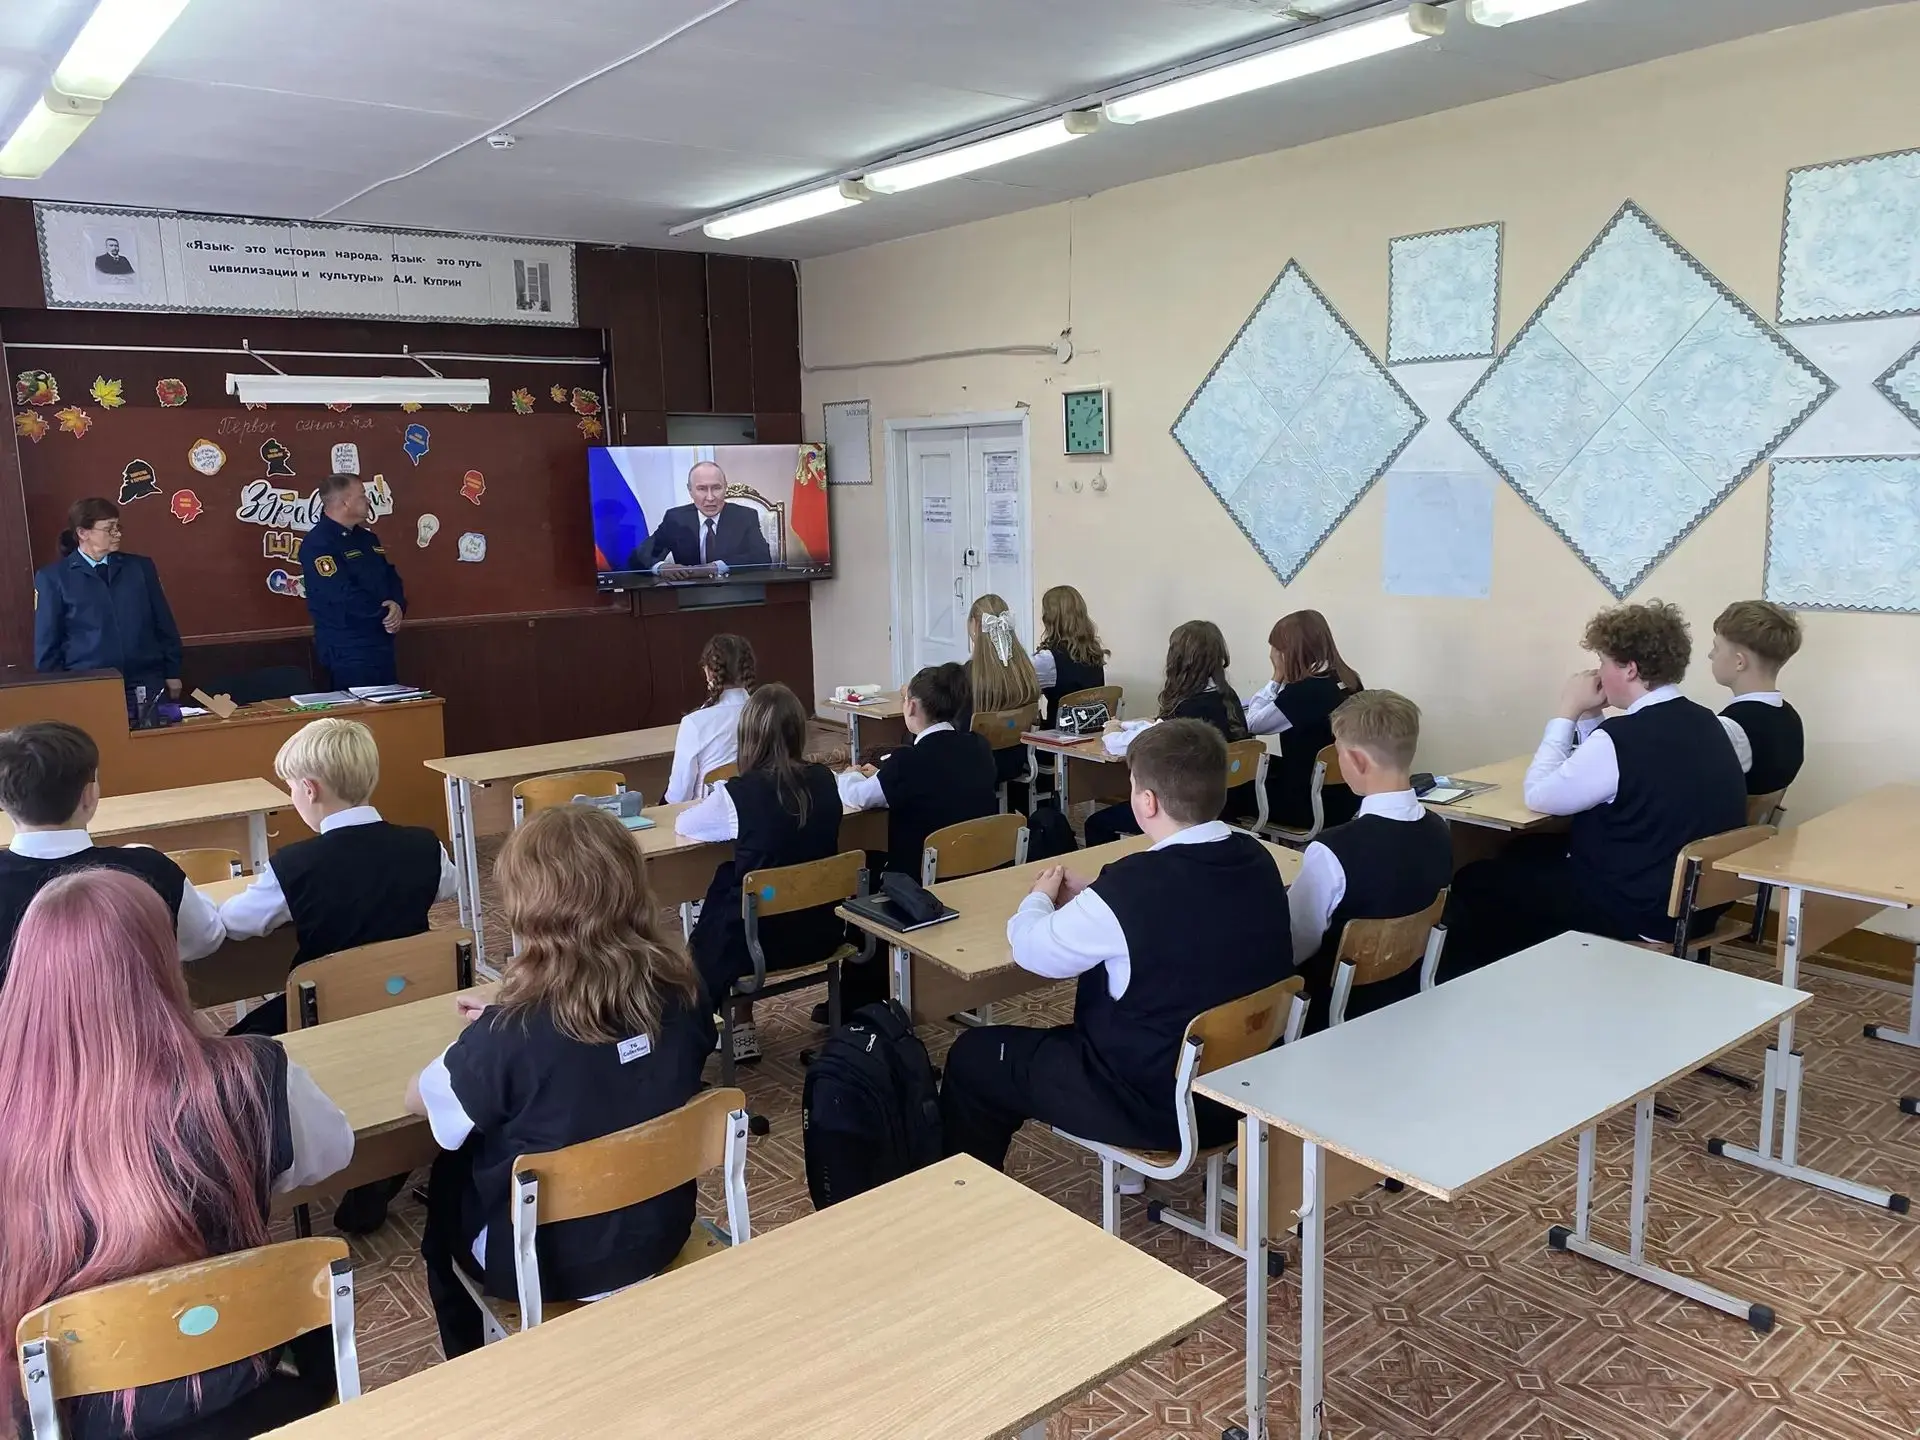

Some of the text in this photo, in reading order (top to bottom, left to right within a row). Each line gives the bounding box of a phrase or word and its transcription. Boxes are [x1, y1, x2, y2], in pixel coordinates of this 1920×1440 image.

[186, 240, 482, 269] «Язык- это история народа. Язык- это путь
[209, 264, 298, 278] цивилизации
[302, 270, 310, 279] и
[319, 271, 384, 283] культуры»
[393, 275, 417, 285] А.И.
[218, 416, 277, 443] Первое
